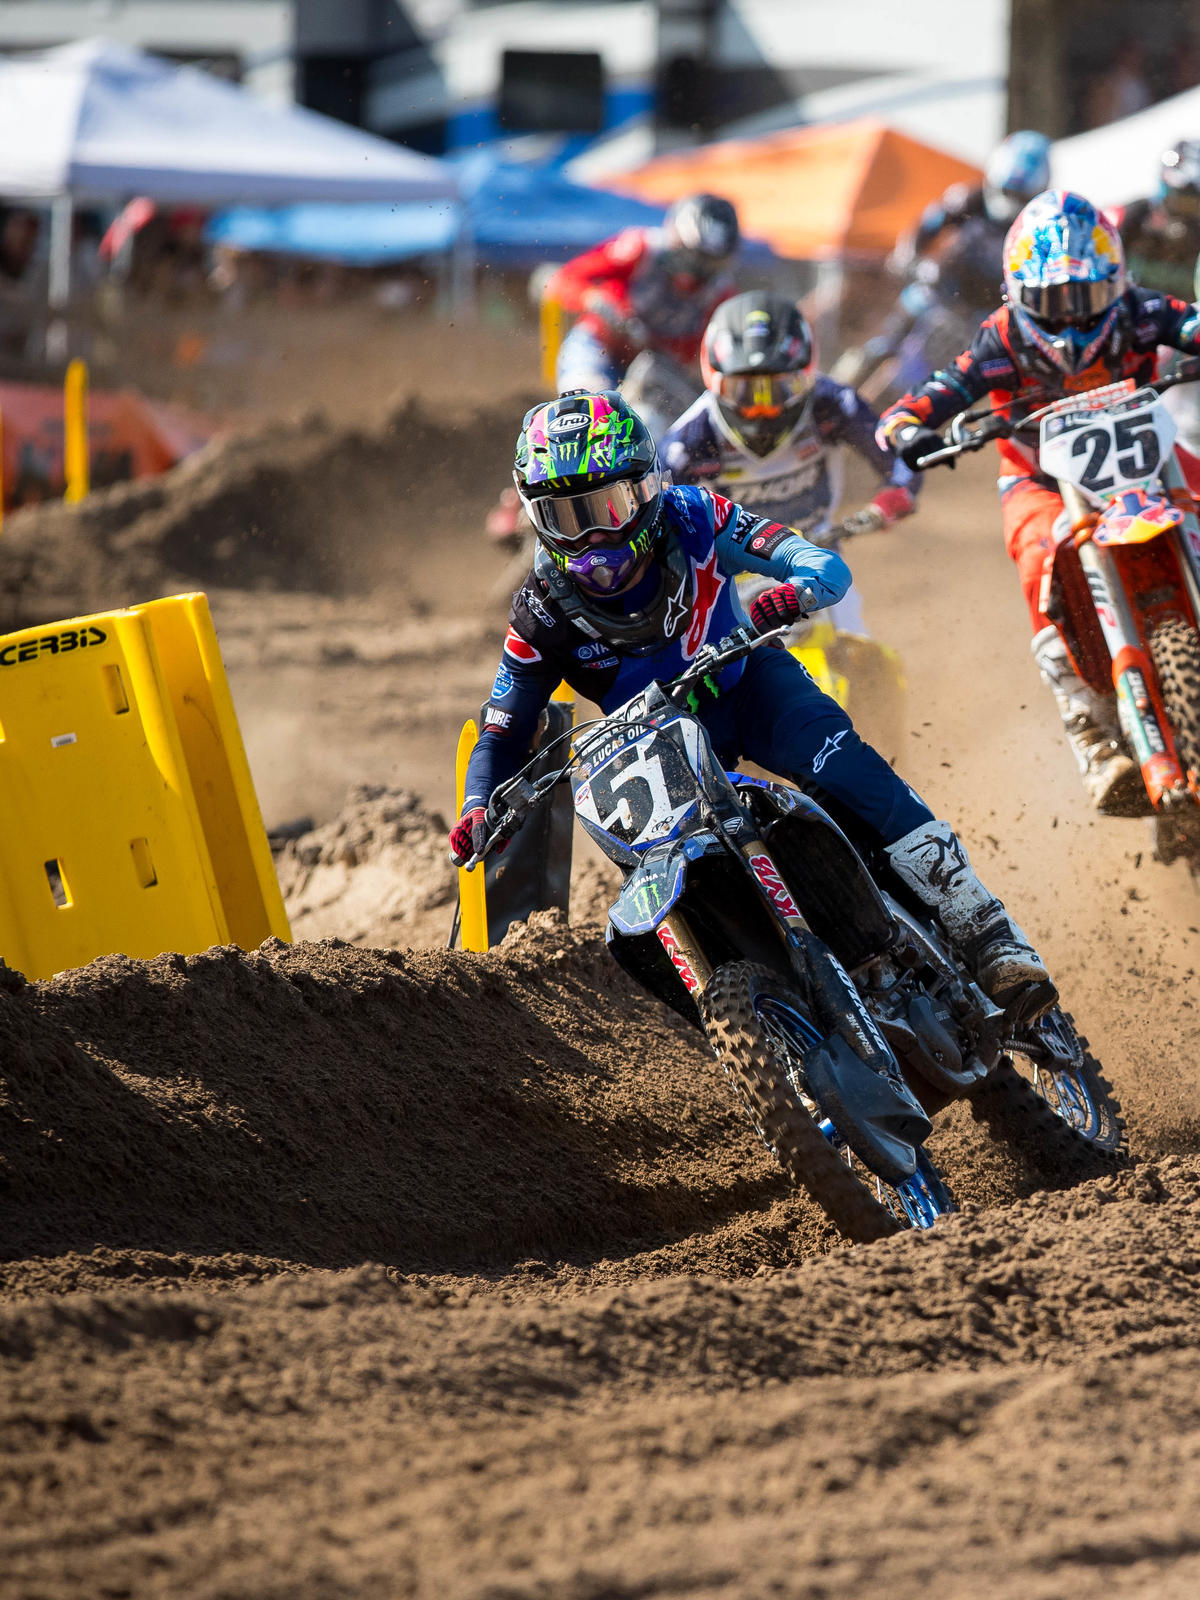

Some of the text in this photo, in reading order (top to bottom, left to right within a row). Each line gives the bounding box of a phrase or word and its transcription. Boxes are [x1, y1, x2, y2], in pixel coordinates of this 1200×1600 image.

[555, 415, 586, 427] Arai
[1071, 413, 1160, 492] 25
[592, 734, 625, 768] LUCAS
[627, 723, 648, 741] OIL
[589, 721, 698, 846] 51
[749, 854, 802, 918] KYB
[824, 953, 891, 1058] DUNLOP
